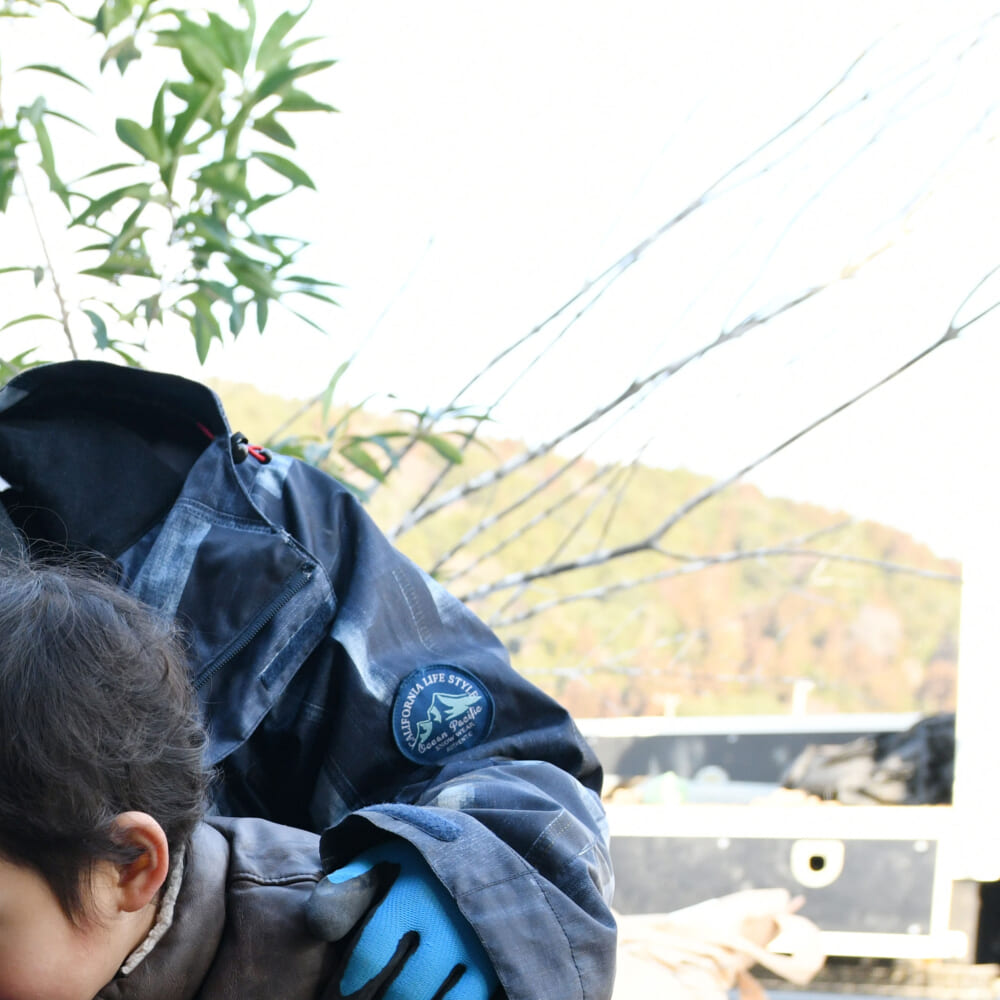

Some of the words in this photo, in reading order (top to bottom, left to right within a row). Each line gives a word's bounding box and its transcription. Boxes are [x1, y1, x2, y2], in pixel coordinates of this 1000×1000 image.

[401, 683, 425, 750] CALIFORNIA
[422, 673, 446, 687] LIFE
[448, 674, 479, 697] STYLE
[418, 731, 449, 754] Ocean
[449, 706, 482, 731] Pacific
[446, 731, 473, 752] AUTHENTC
[455, 721, 476, 738] WEAR
